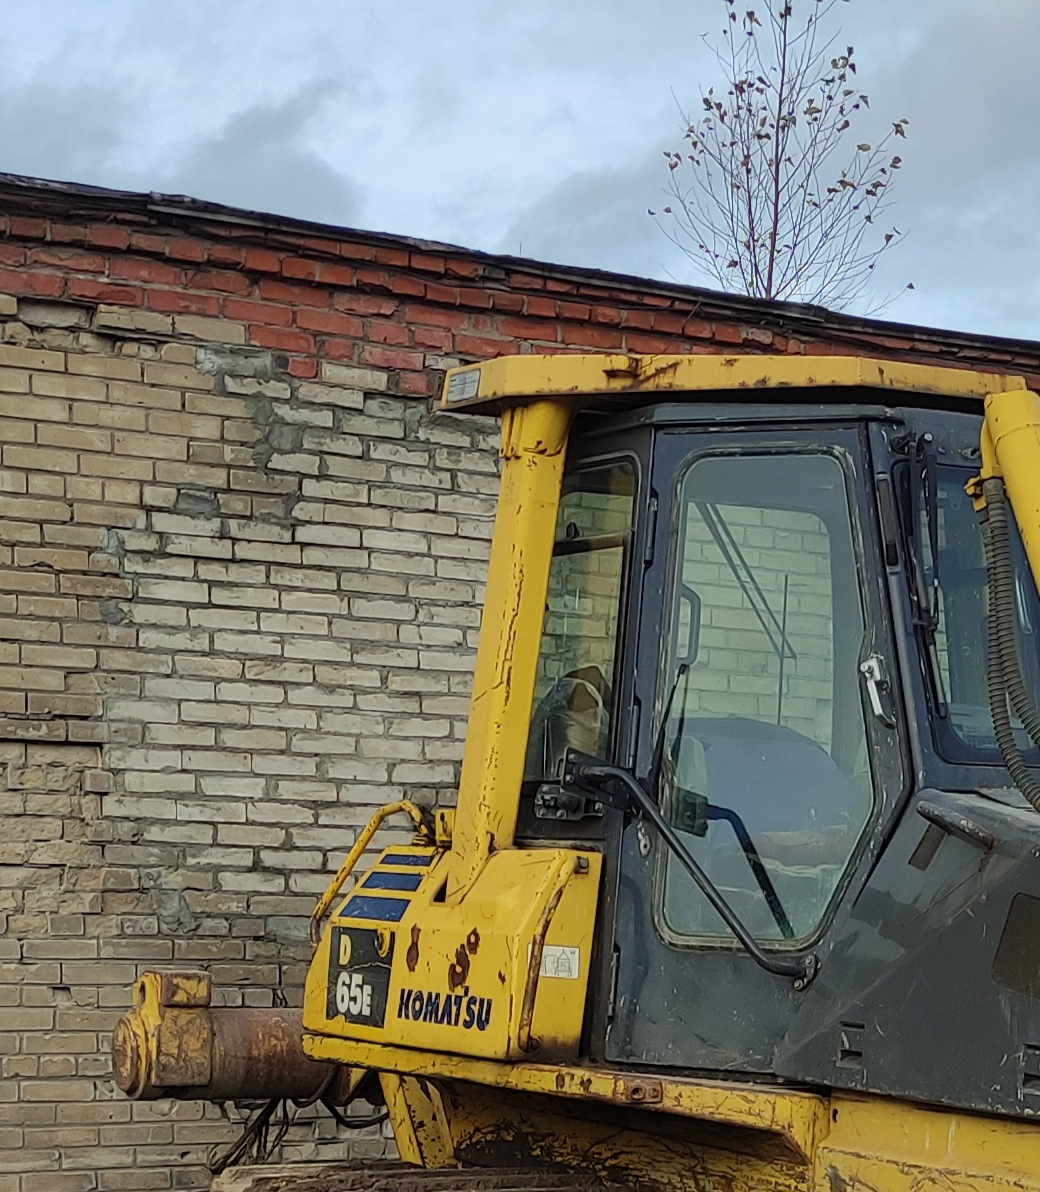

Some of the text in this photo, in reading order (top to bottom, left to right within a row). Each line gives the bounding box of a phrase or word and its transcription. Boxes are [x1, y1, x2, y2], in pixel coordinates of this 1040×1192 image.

[338, 934, 352, 966] D
[335, 971, 373, 1017] 65E
[397, 985, 492, 1031] KOMATSU
